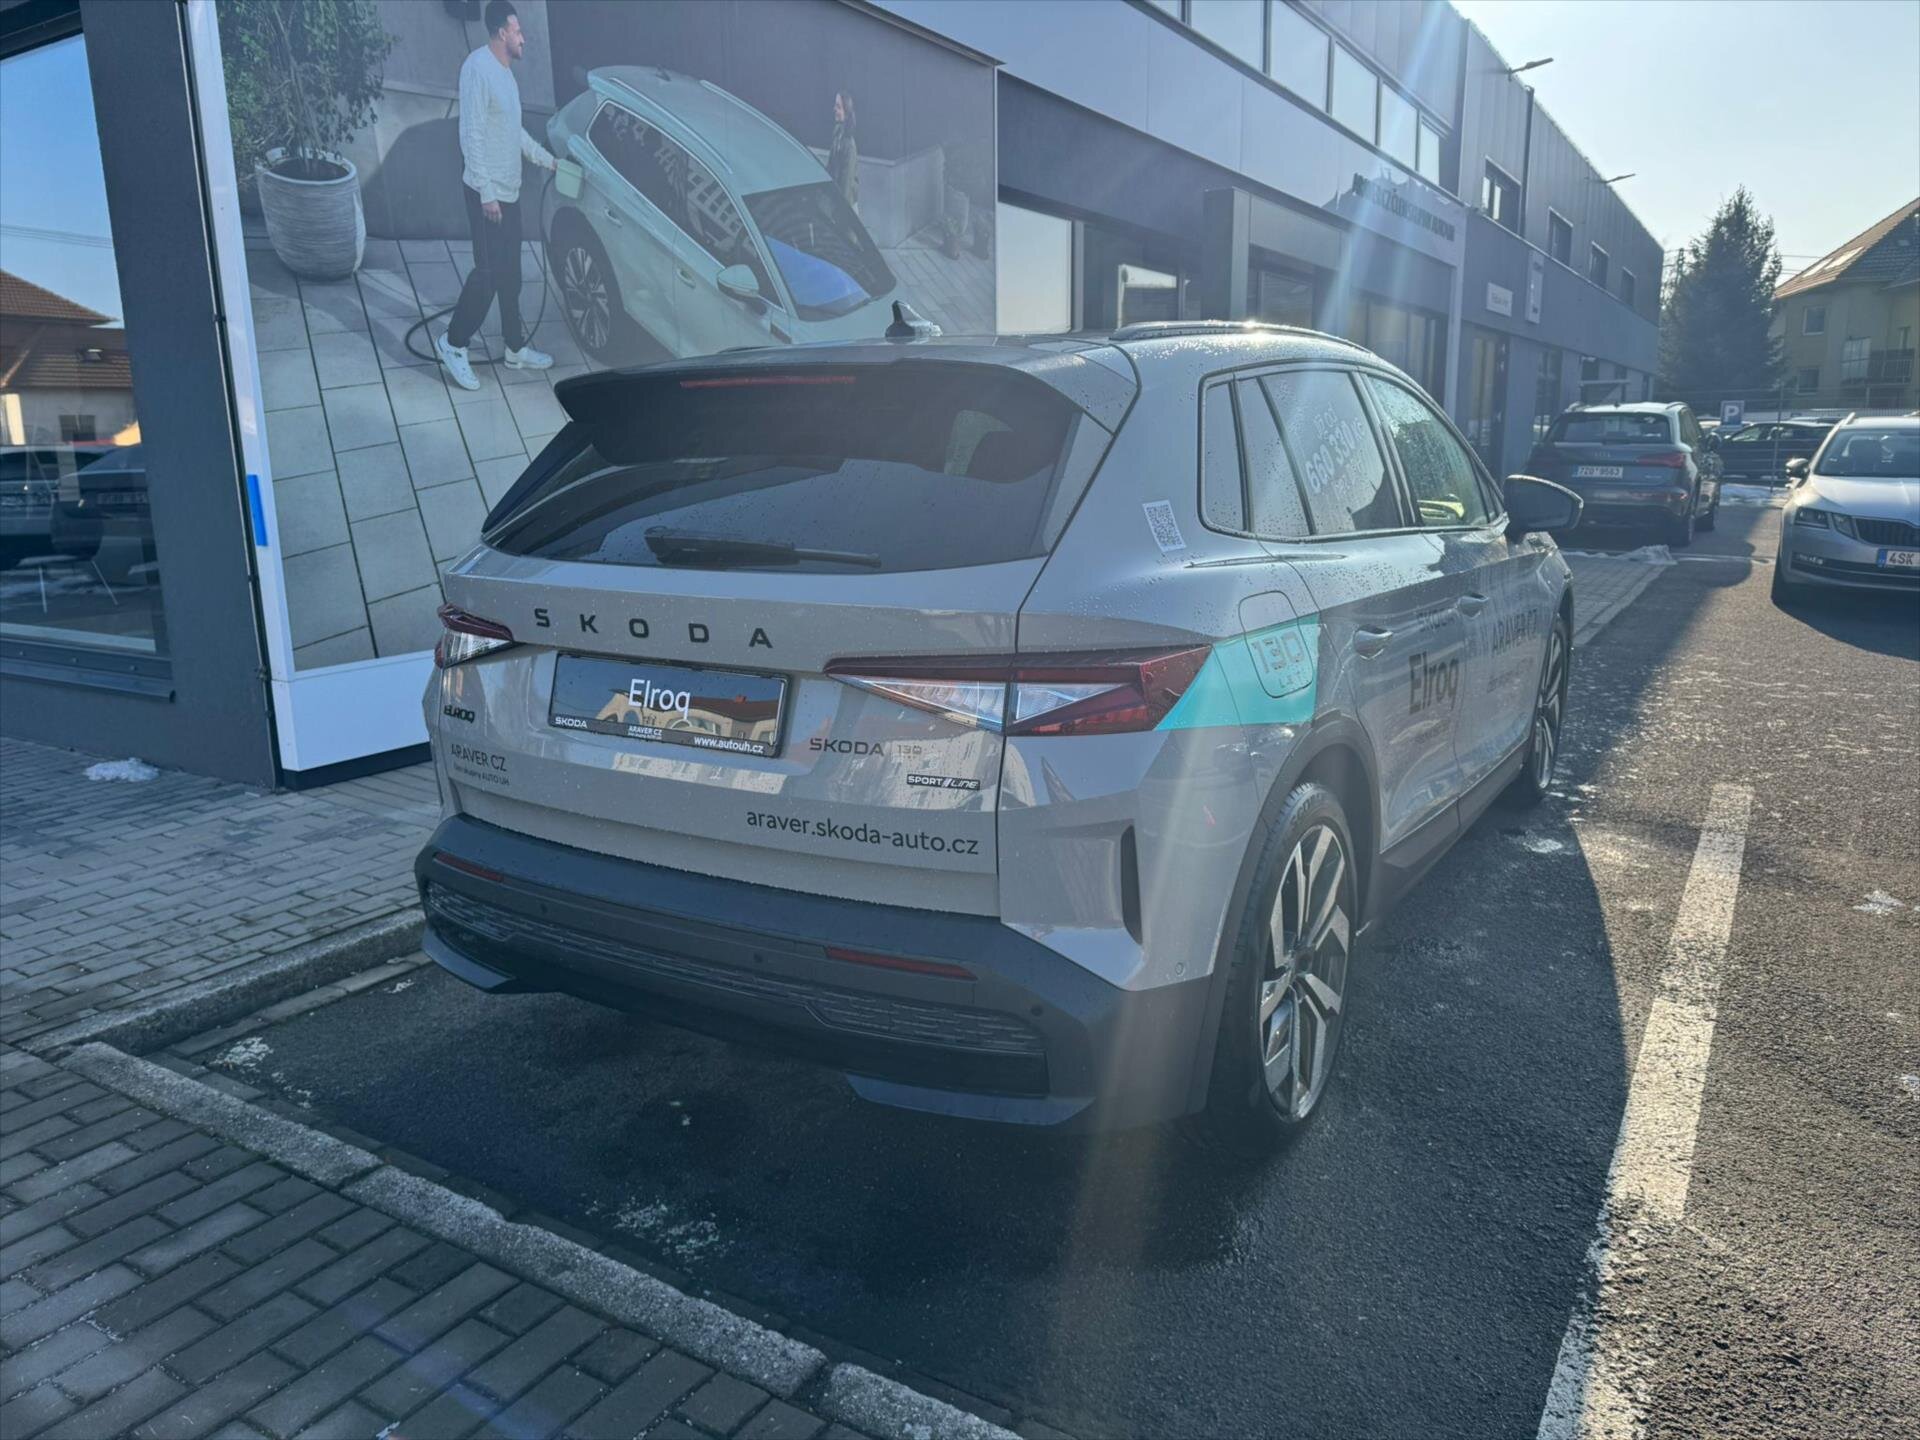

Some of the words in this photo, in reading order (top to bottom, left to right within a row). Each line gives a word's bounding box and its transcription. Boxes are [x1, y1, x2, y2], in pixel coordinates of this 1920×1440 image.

[1304, 443, 1335, 494] 660
[1889, 552, 1914, 565] 4SK
[1409, 651, 1459, 714] Elroq
[628, 678, 691, 721] Elroq
[555, 716, 588, 729] SKODA
[628, 725, 652, 735] ARAVER
[694, 735, 764, 754] www.autouh.cz
[490, 755, 507, 772] CZ
[747, 810, 979, 855] araver.skoda-auto.cz
